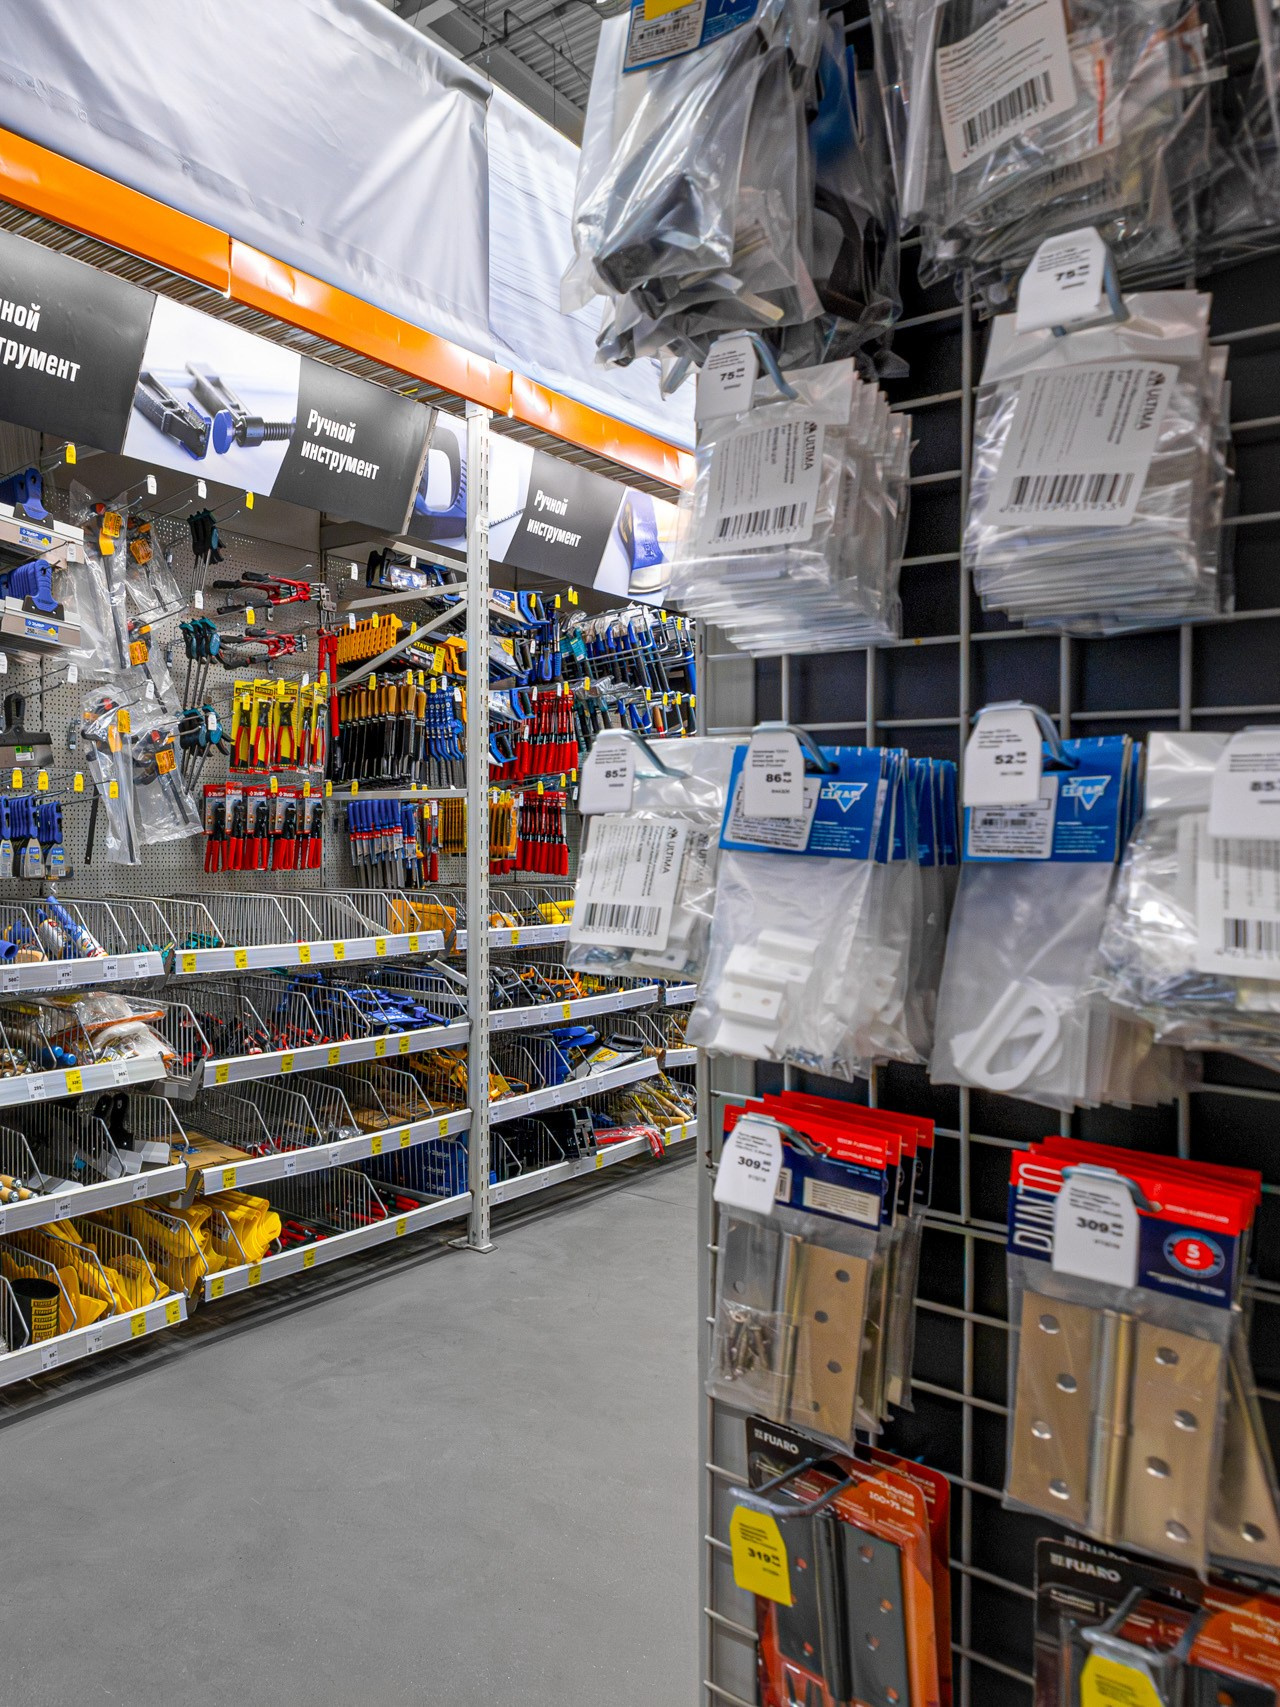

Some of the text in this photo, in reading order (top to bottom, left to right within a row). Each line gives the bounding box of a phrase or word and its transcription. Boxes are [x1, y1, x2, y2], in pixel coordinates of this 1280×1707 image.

[720, 371, 735, 381] 75
[306, 408, 356, 444] Ручной
[300, 440, 380, 480] инструмент
[804, 434, 816, 471] ULTIMA
[533, 489, 569, 516] Ручной
[526, 518, 582, 548] инструмент
[413, 641, 434, 653] STAYER
[994, 754, 1014, 764] 52
[605, 770, 619, 778] 85
[766, 773, 782, 783] 86
[662, 839, 679, 874] ULTIMA
[737, 1156, 761, 1170] 309
[1076, 1216, 1110, 1233] 309
[762, 1433, 800, 1455] FUARO
[1064, 1556, 1122, 1583] FUARO
